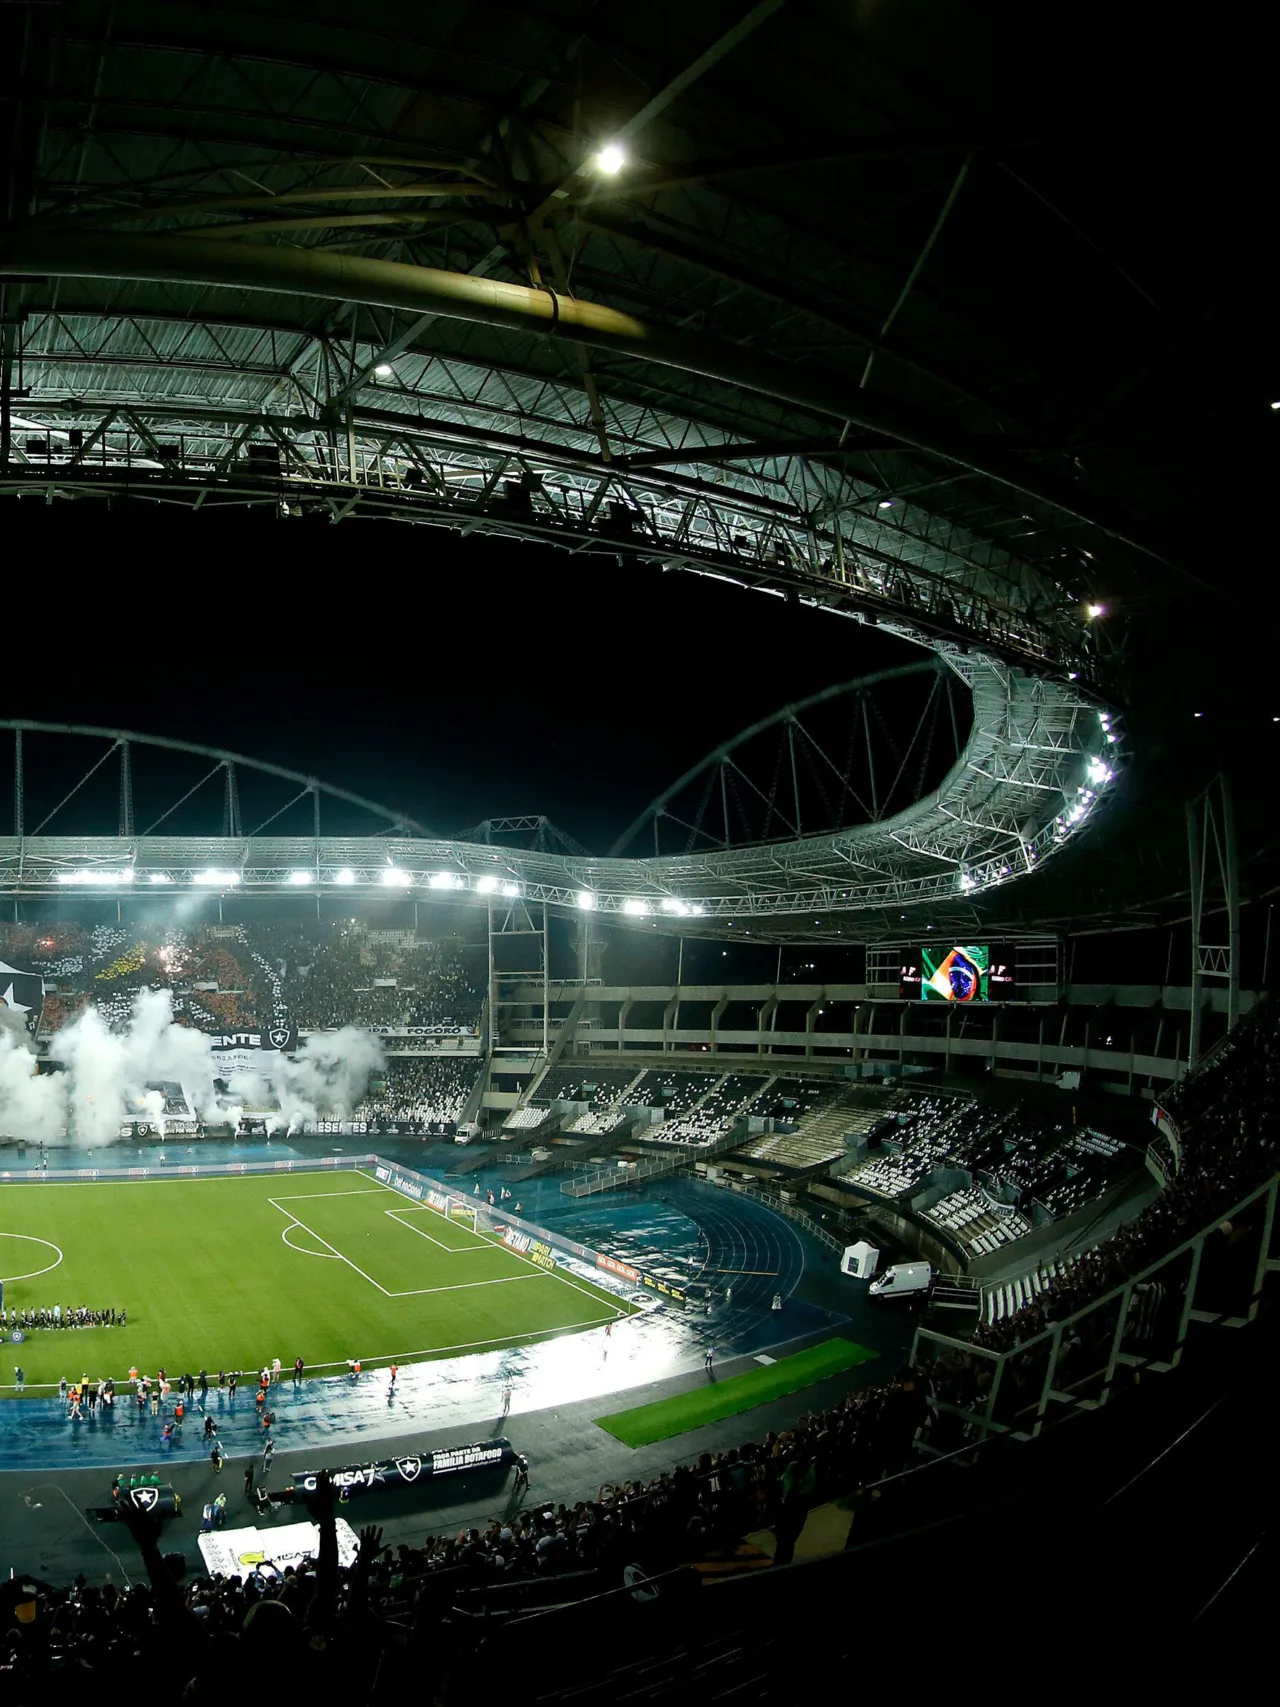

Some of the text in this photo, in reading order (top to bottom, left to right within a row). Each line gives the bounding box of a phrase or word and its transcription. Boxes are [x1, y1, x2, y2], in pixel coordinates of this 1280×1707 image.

[211, 1033, 262, 1047] ENTE
[464, 1448, 503, 1464] BOTAFOGO
[304, 1468, 375, 1490] CMISA7
